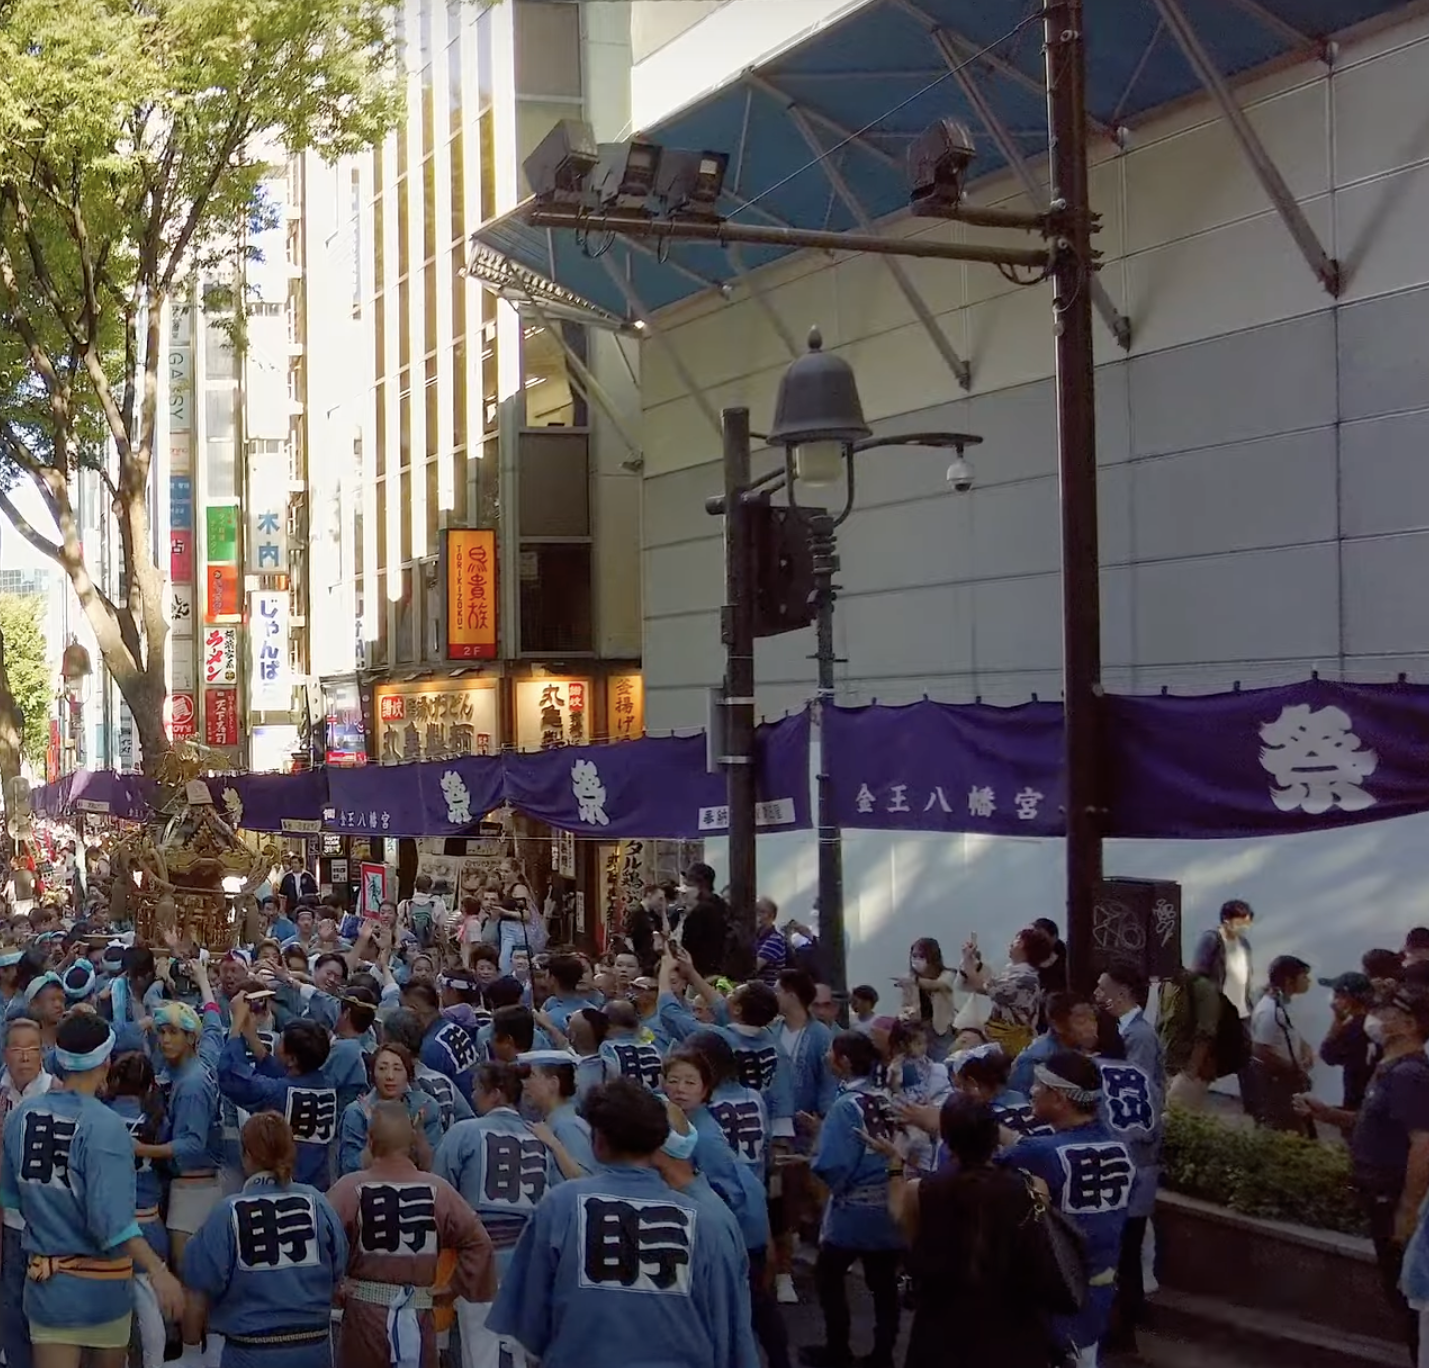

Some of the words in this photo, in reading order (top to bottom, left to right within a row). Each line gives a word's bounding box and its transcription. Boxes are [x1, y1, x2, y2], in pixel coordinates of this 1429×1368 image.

[257, 509, 281, 568] 木内
[206, 629, 223, 682] ラーメン
[463, 646, 481, 656] 2F
[382, 721, 477, 762] 丸亀製麺
[1258, 703, 1380, 815] 祭
[439, 769, 472, 824] 祭
[571, 758, 610, 826] 祭
[855, 783, 1044, 820] 金王八幡宮
[338, 810, 391, 830] 金王八幡宮
